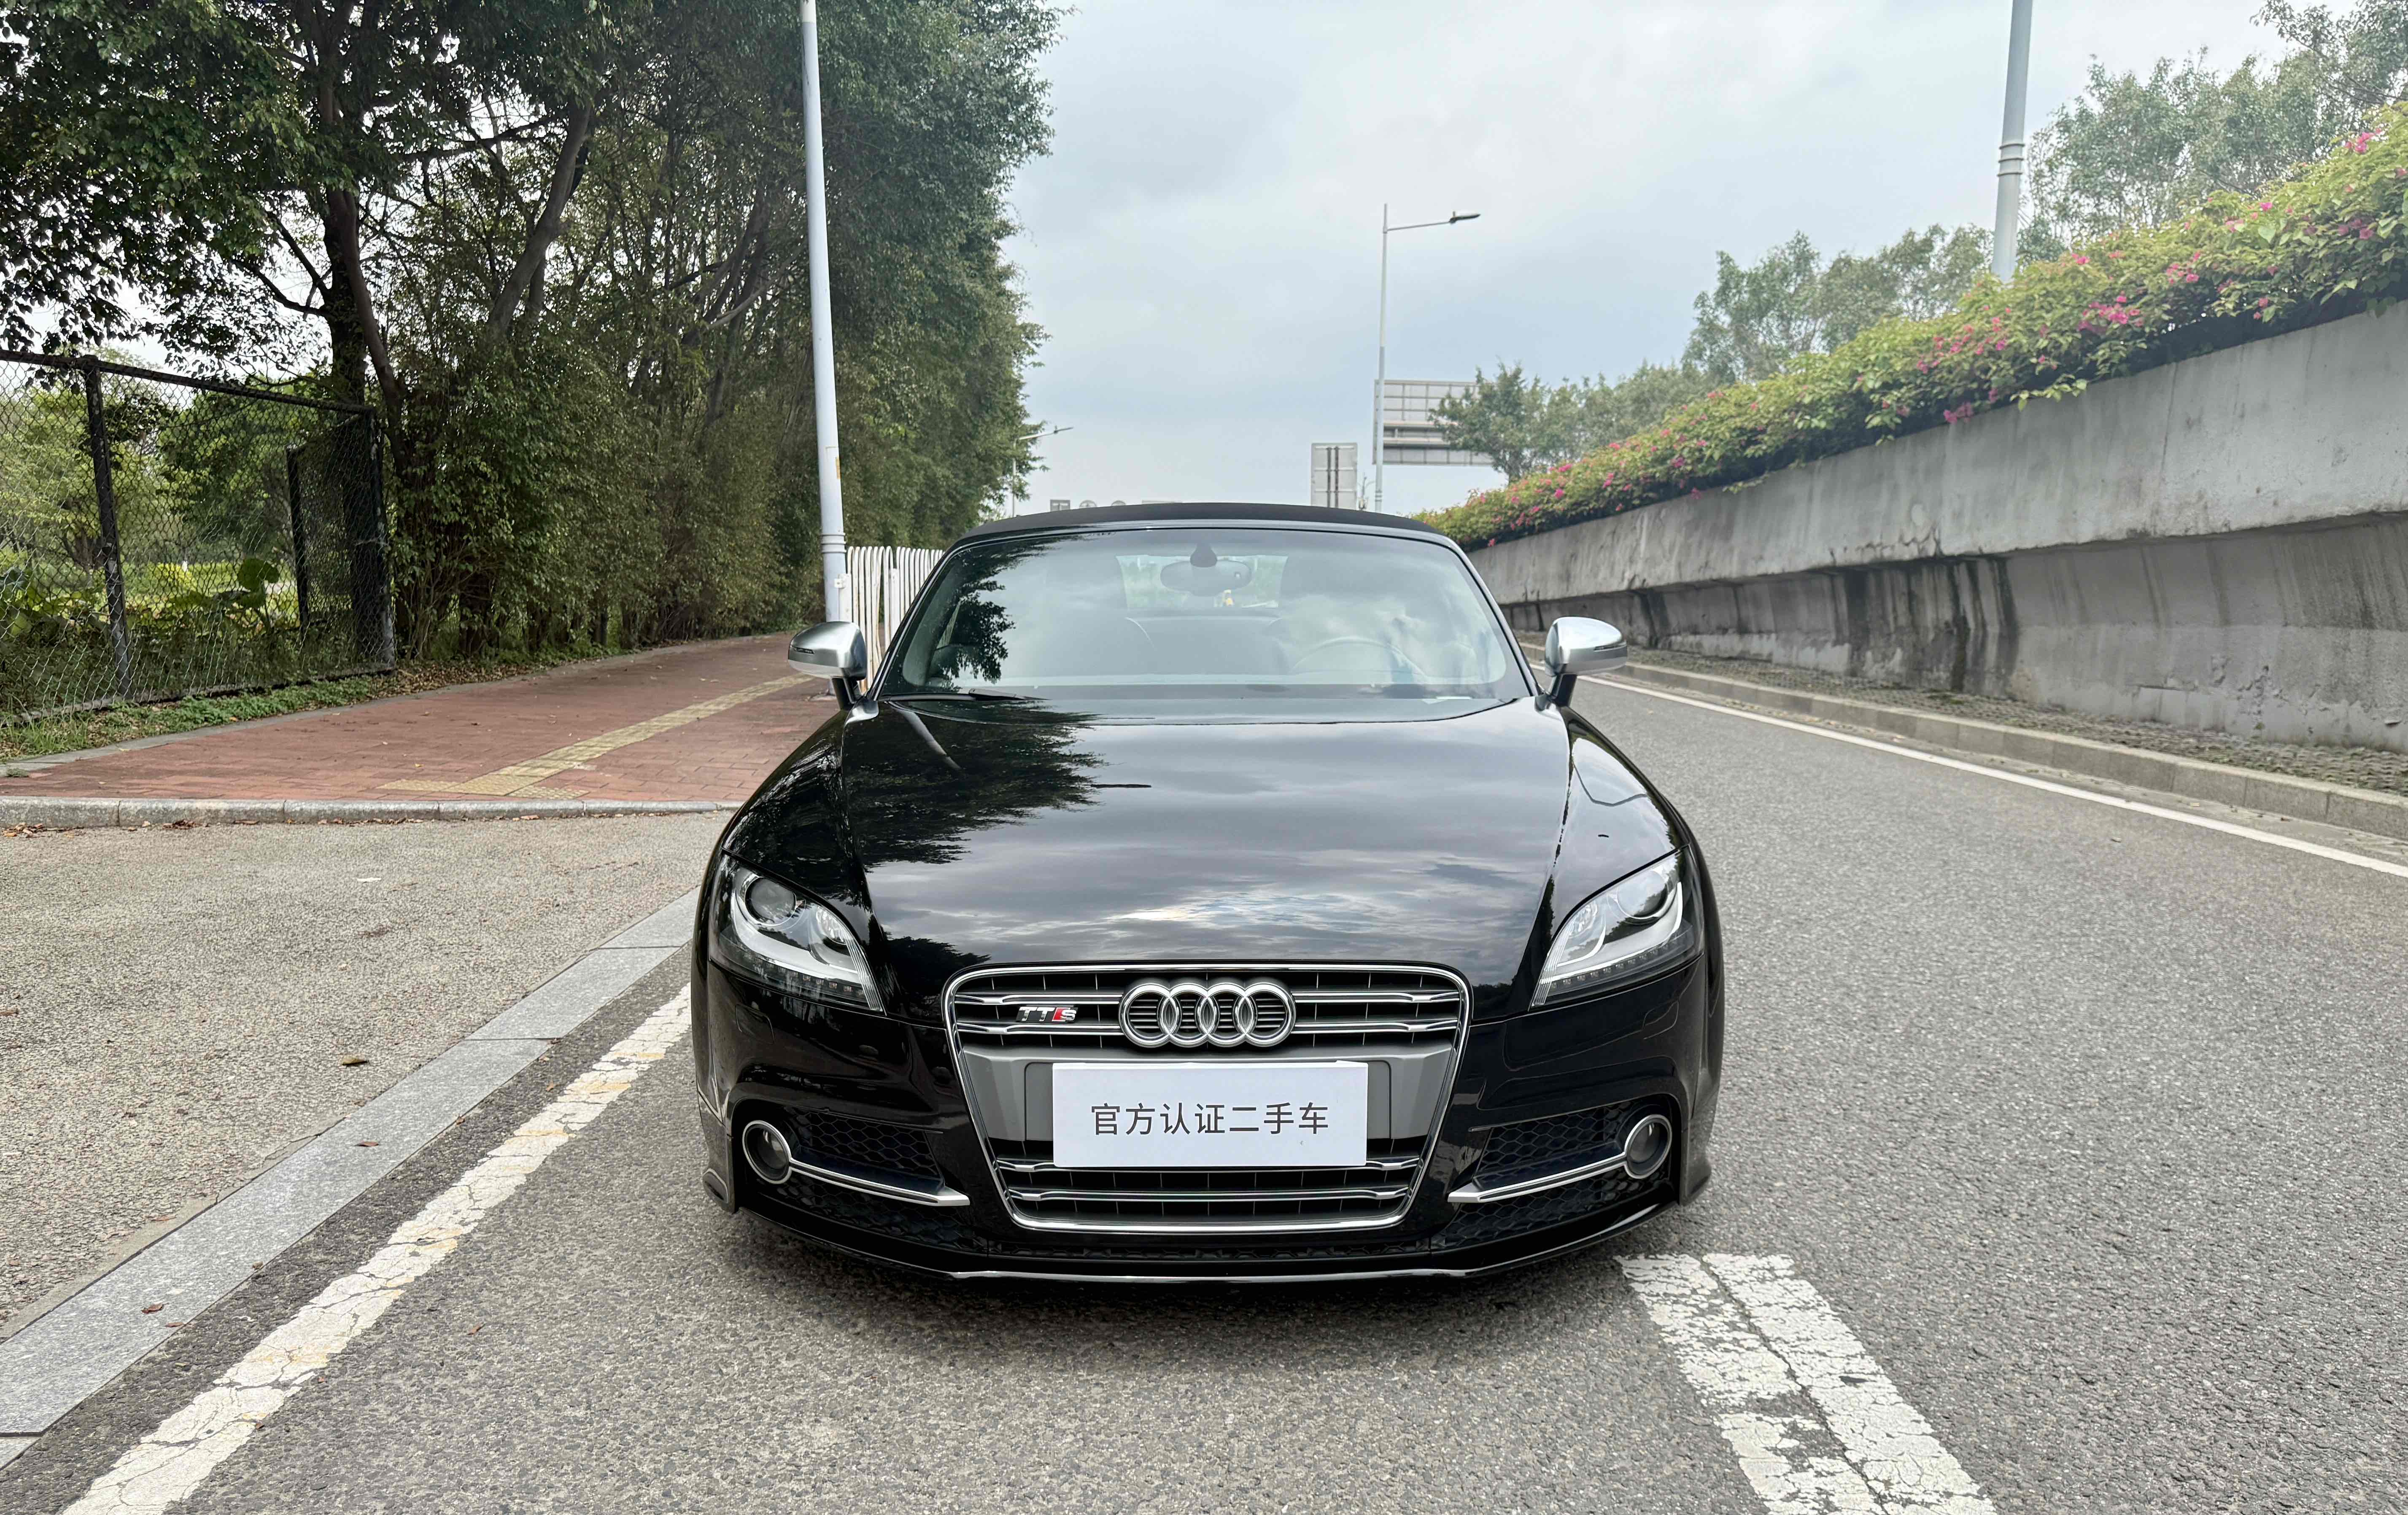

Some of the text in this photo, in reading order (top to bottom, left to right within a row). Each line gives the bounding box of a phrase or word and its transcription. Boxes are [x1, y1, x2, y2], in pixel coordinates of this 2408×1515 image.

[1019, 1006, 1077, 1022] TTS
[1091, 1102, 1328, 1135] 官方认证二手车
